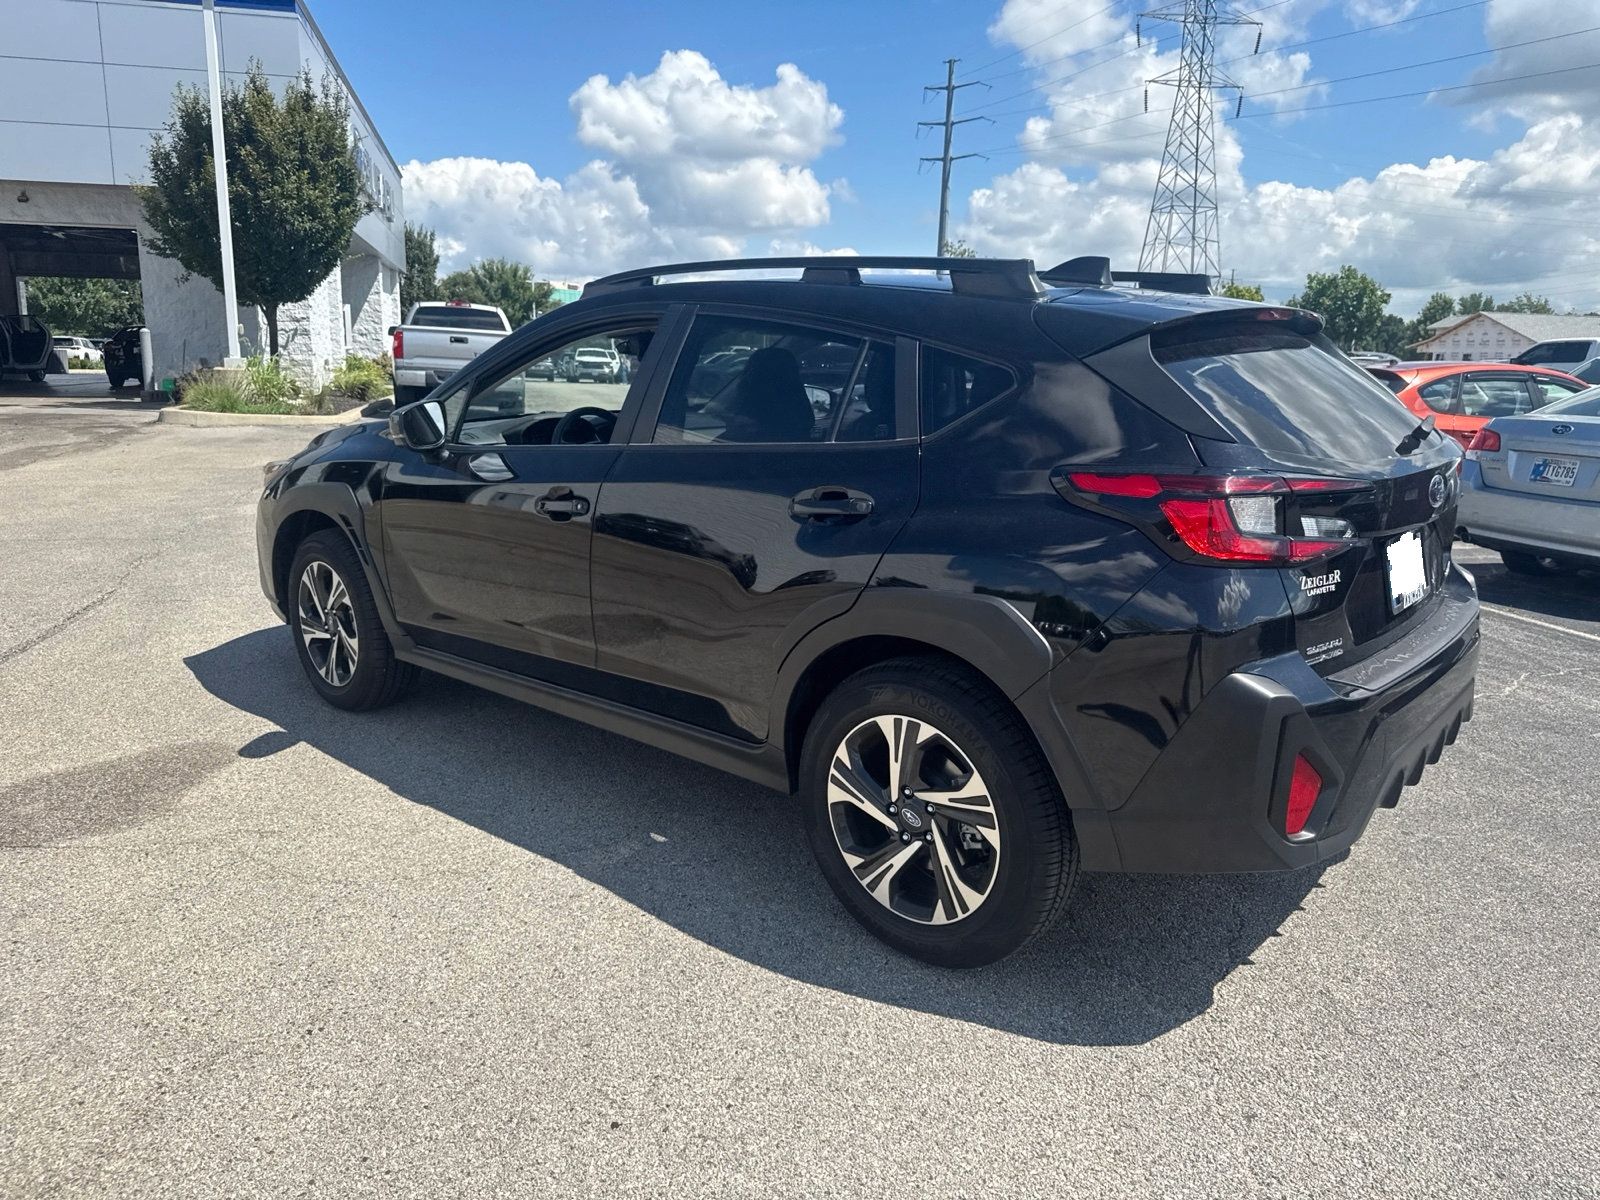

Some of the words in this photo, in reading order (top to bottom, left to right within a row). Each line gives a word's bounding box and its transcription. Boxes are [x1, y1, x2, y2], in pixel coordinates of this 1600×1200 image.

[1299, 569, 1341, 590] ZEIGLER
[1306, 584, 1336, 597] LAFAYETTE
[1306, 637, 1343, 655] SUBARU
[909, 690, 989, 758] YOKOHAMA
